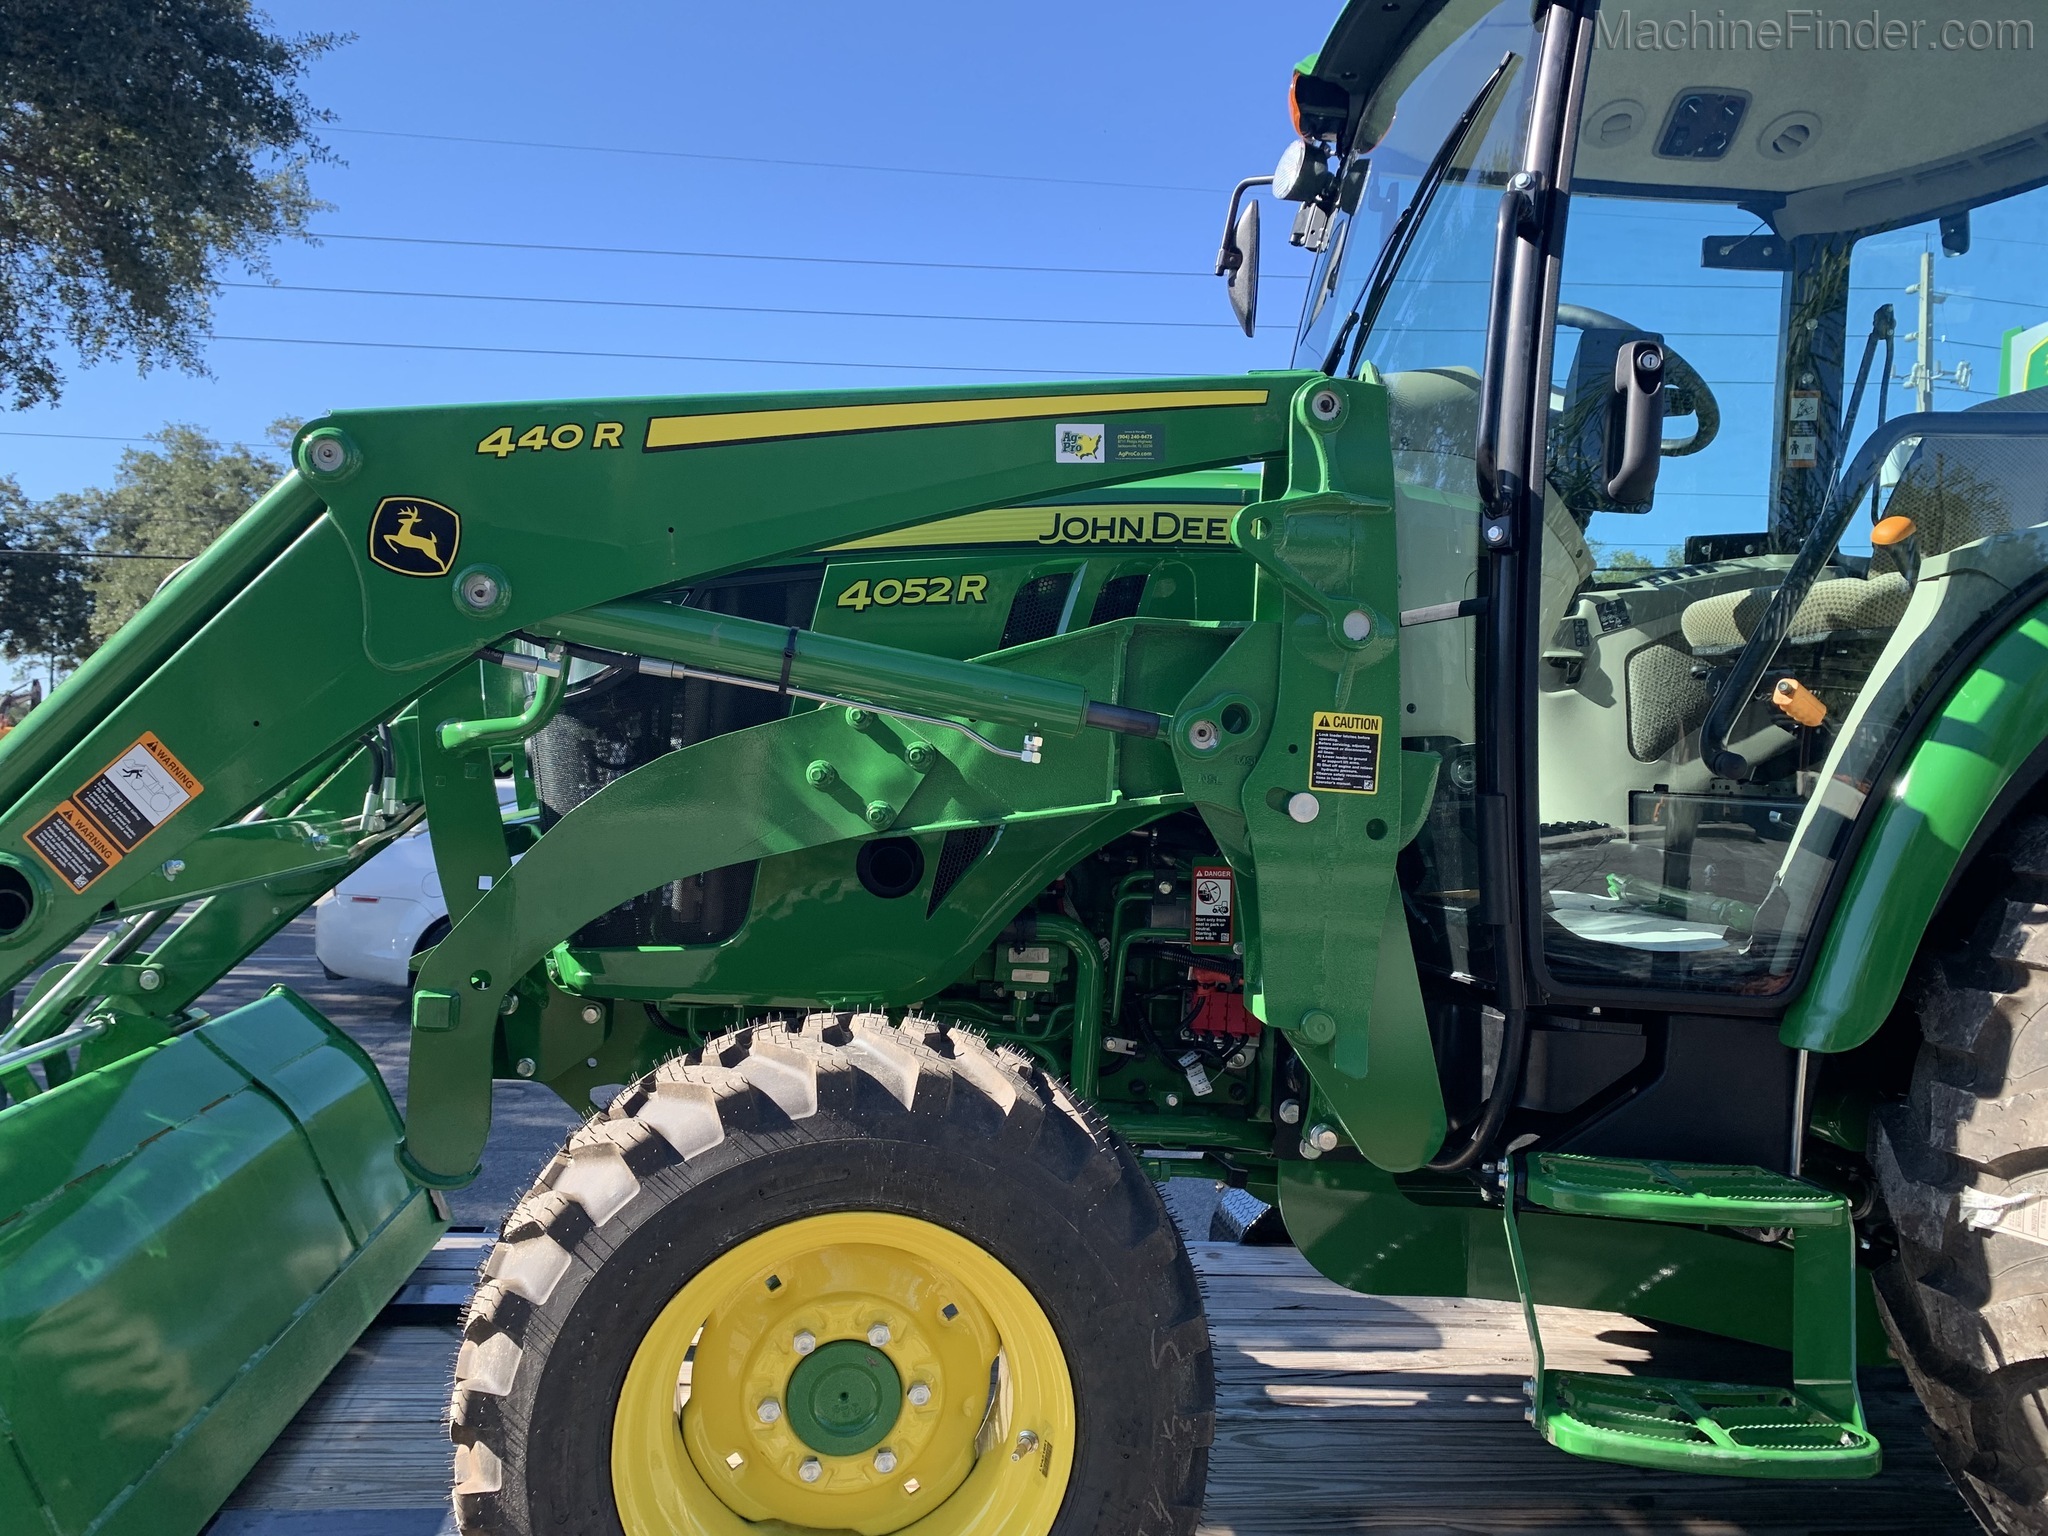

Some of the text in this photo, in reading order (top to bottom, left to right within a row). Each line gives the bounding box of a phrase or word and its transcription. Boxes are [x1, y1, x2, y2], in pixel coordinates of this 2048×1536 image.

[475, 421, 624, 458] 440 R
[1062, 431, 1083, 444] Ag-
[1062, 443, 1082, 453] Pro
[1039, 511, 1231, 543] JOHN DEE
[836, 574, 989, 612] 4052 R
[1333, 715, 1379, 731] CAUTION
[154, 748, 195, 789] WARNING
[72, 818, 113, 859] WARNING
